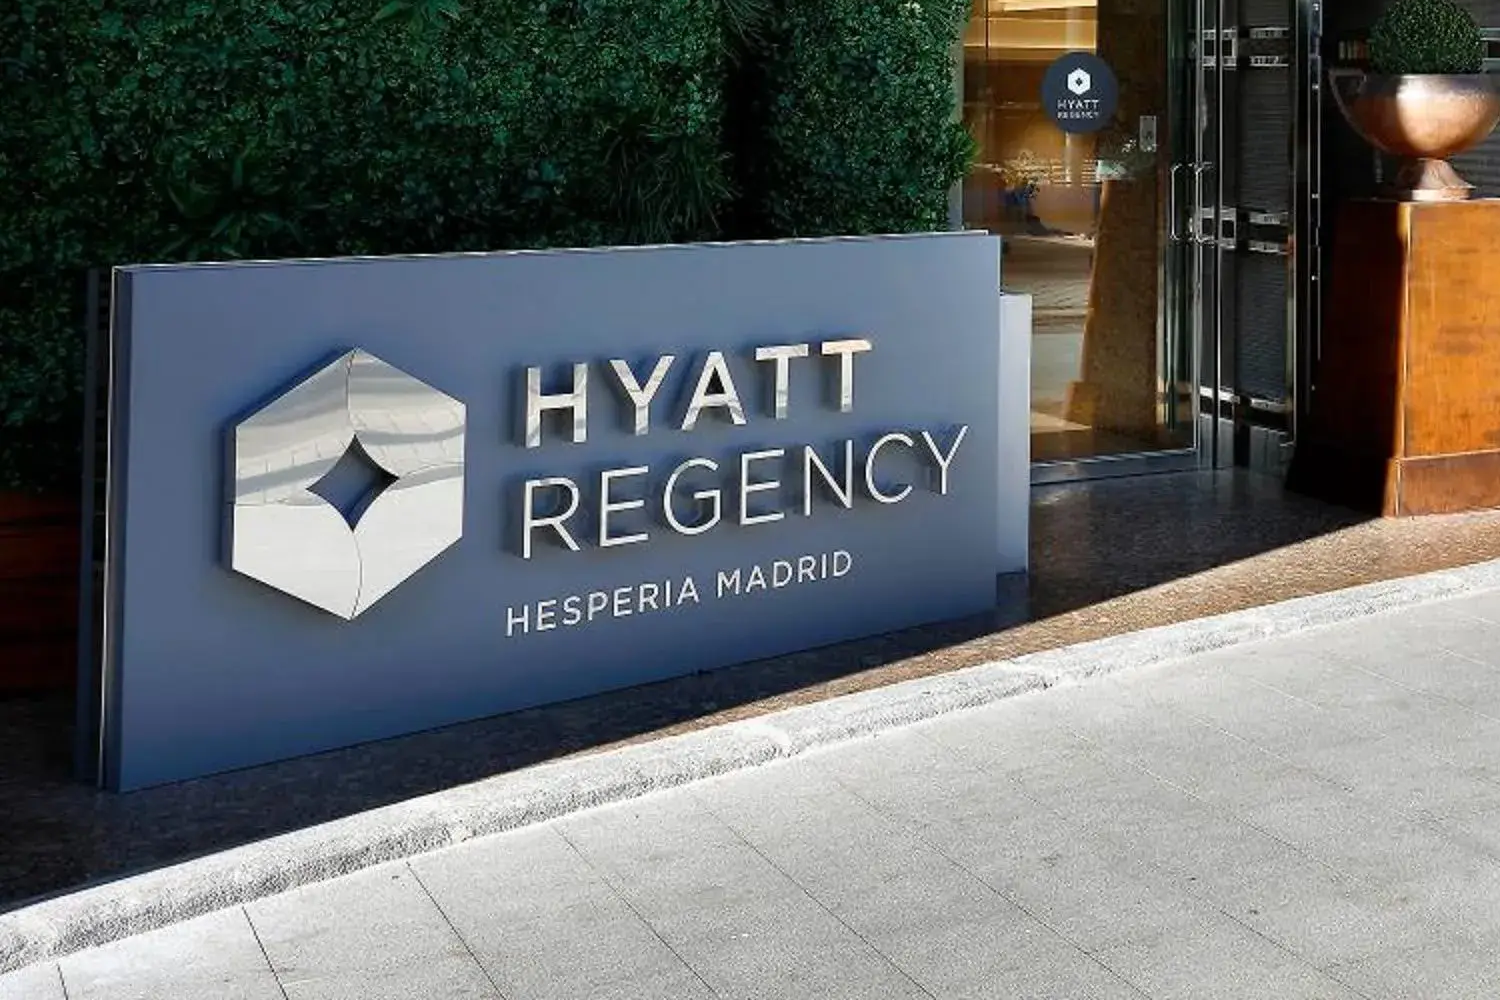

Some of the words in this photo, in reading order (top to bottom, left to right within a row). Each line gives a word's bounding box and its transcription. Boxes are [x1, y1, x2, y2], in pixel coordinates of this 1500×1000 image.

[1057, 99, 1099, 110] HYATT
[524, 339, 872, 448] HYATT
[522, 425, 969, 559] REGENCY
[505, 576, 700, 637] HESPERIA
[717, 550, 853, 597] MADRID
